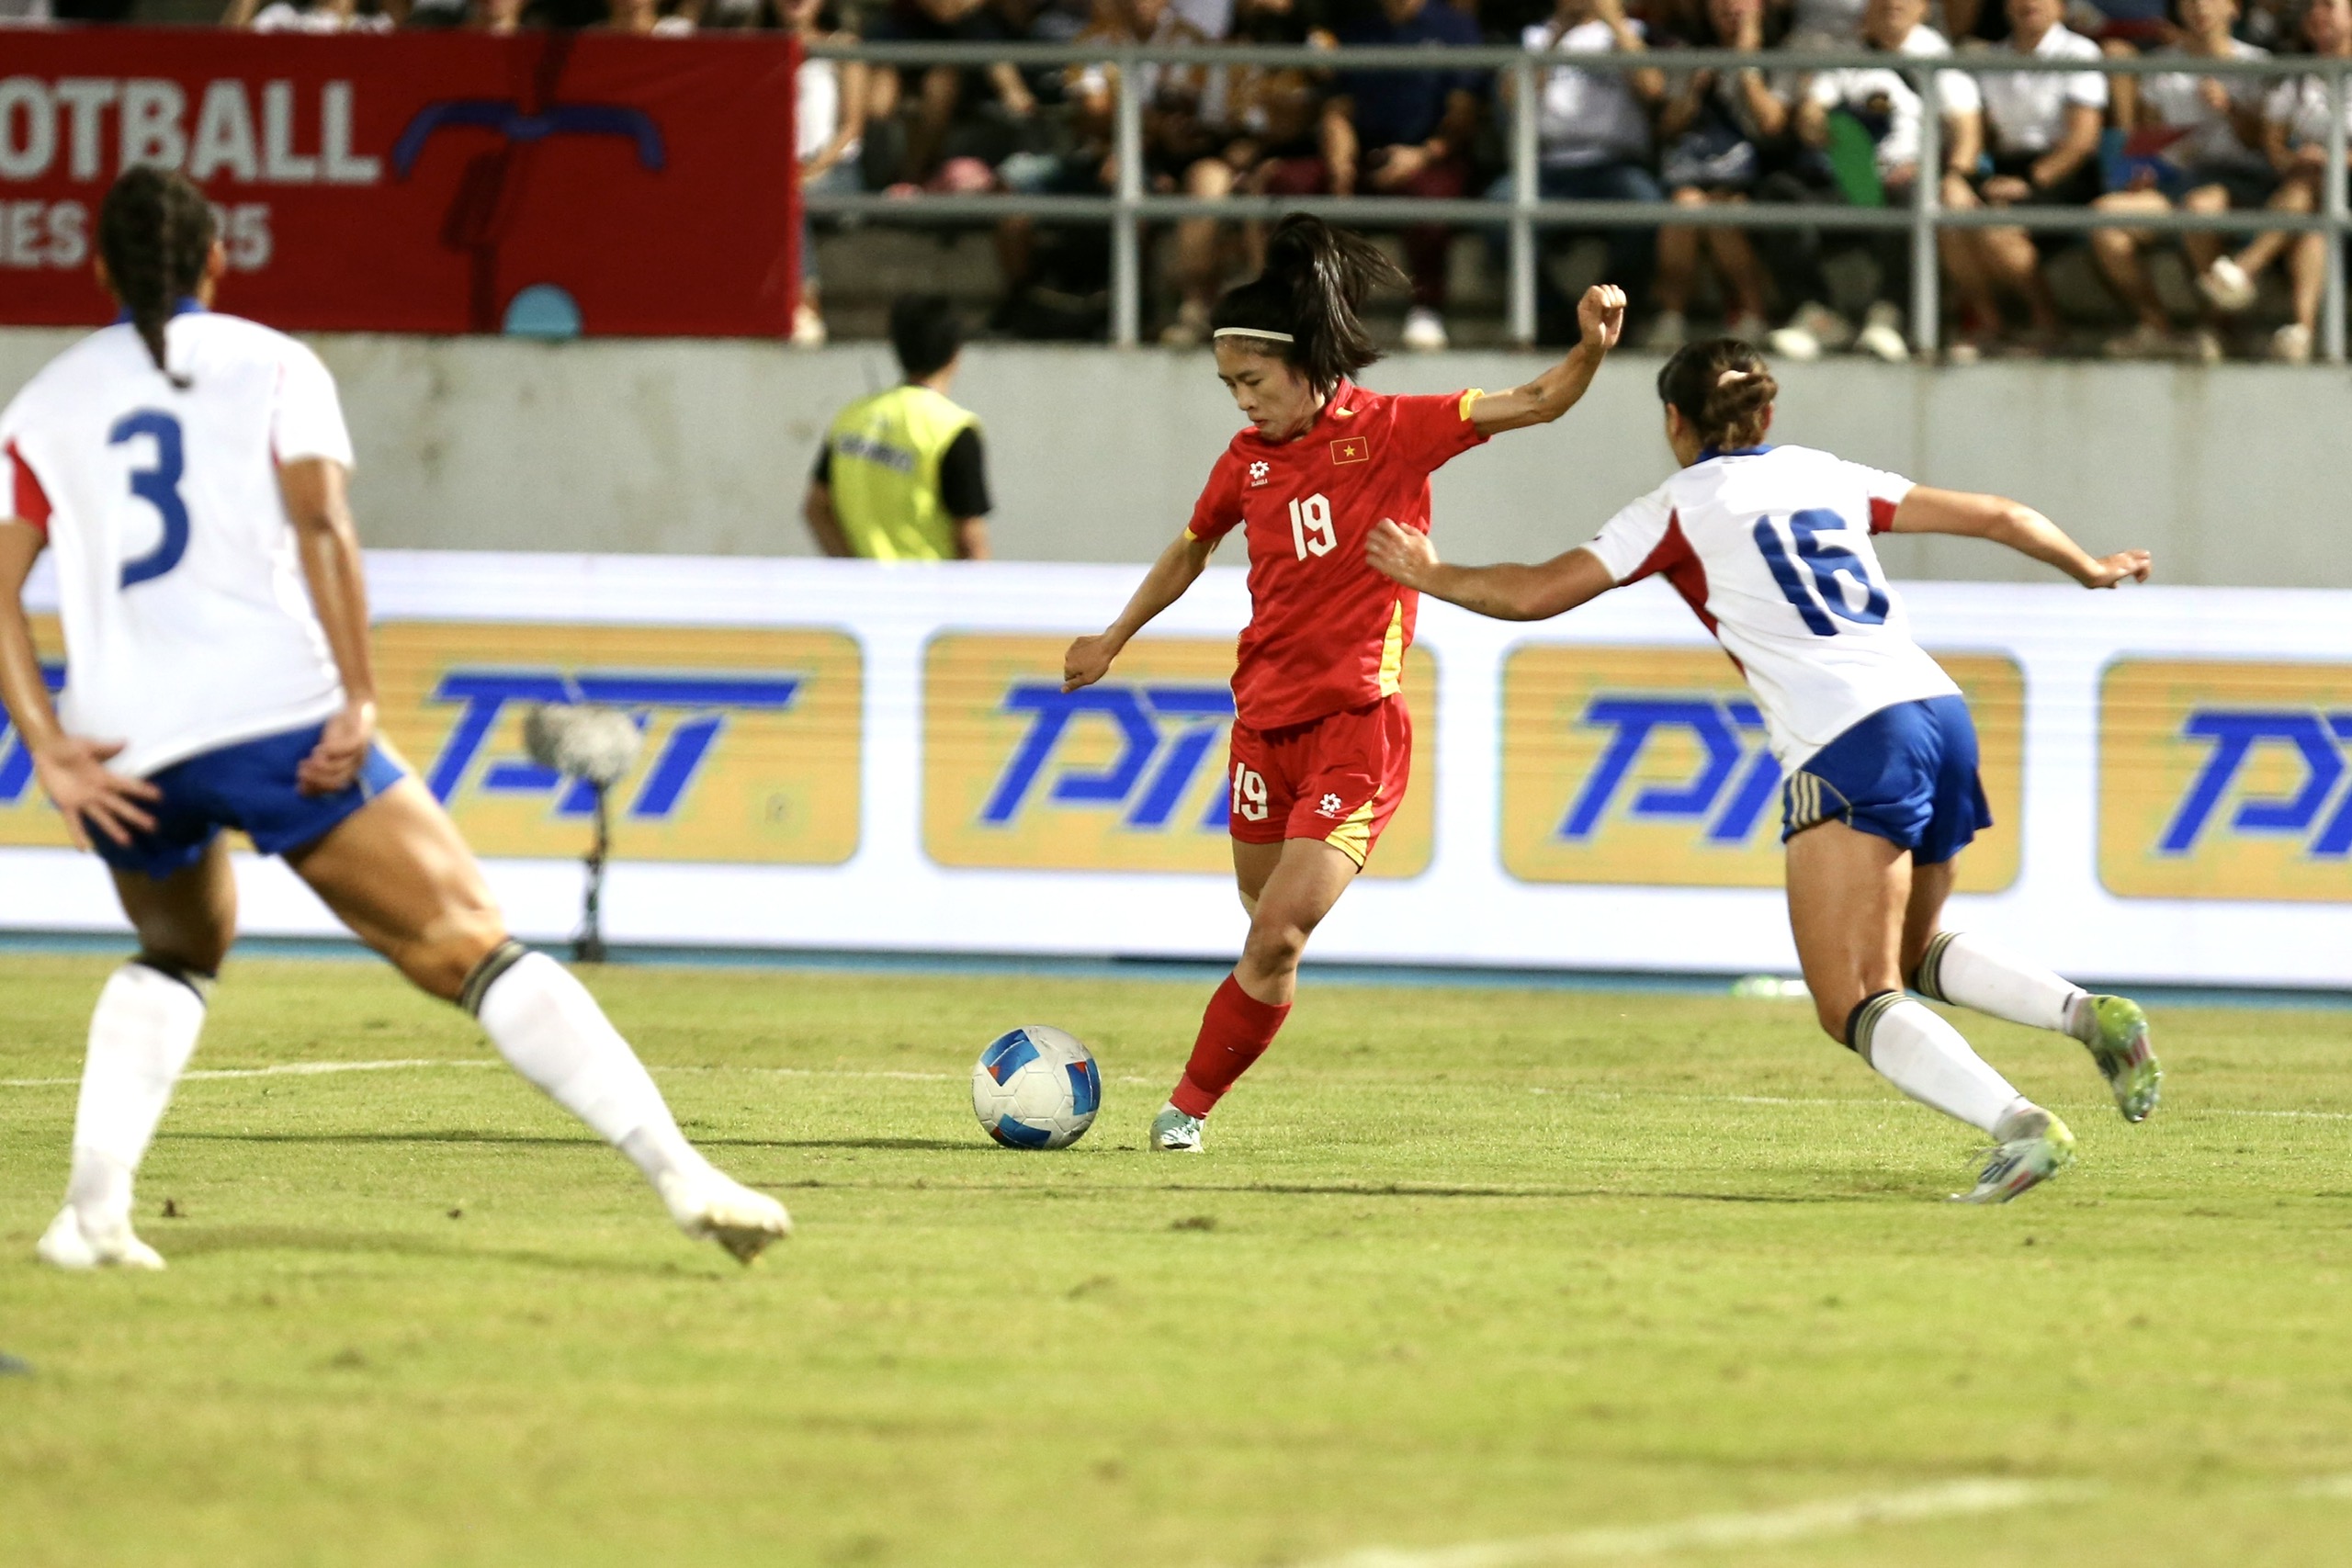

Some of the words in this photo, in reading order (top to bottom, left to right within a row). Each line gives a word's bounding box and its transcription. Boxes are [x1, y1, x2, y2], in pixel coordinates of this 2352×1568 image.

[107, 408, 190, 590] 3
[1288, 492, 1338, 561] 19
[1752, 507, 1890, 637] 16
[1232, 761, 1269, 822] 19
